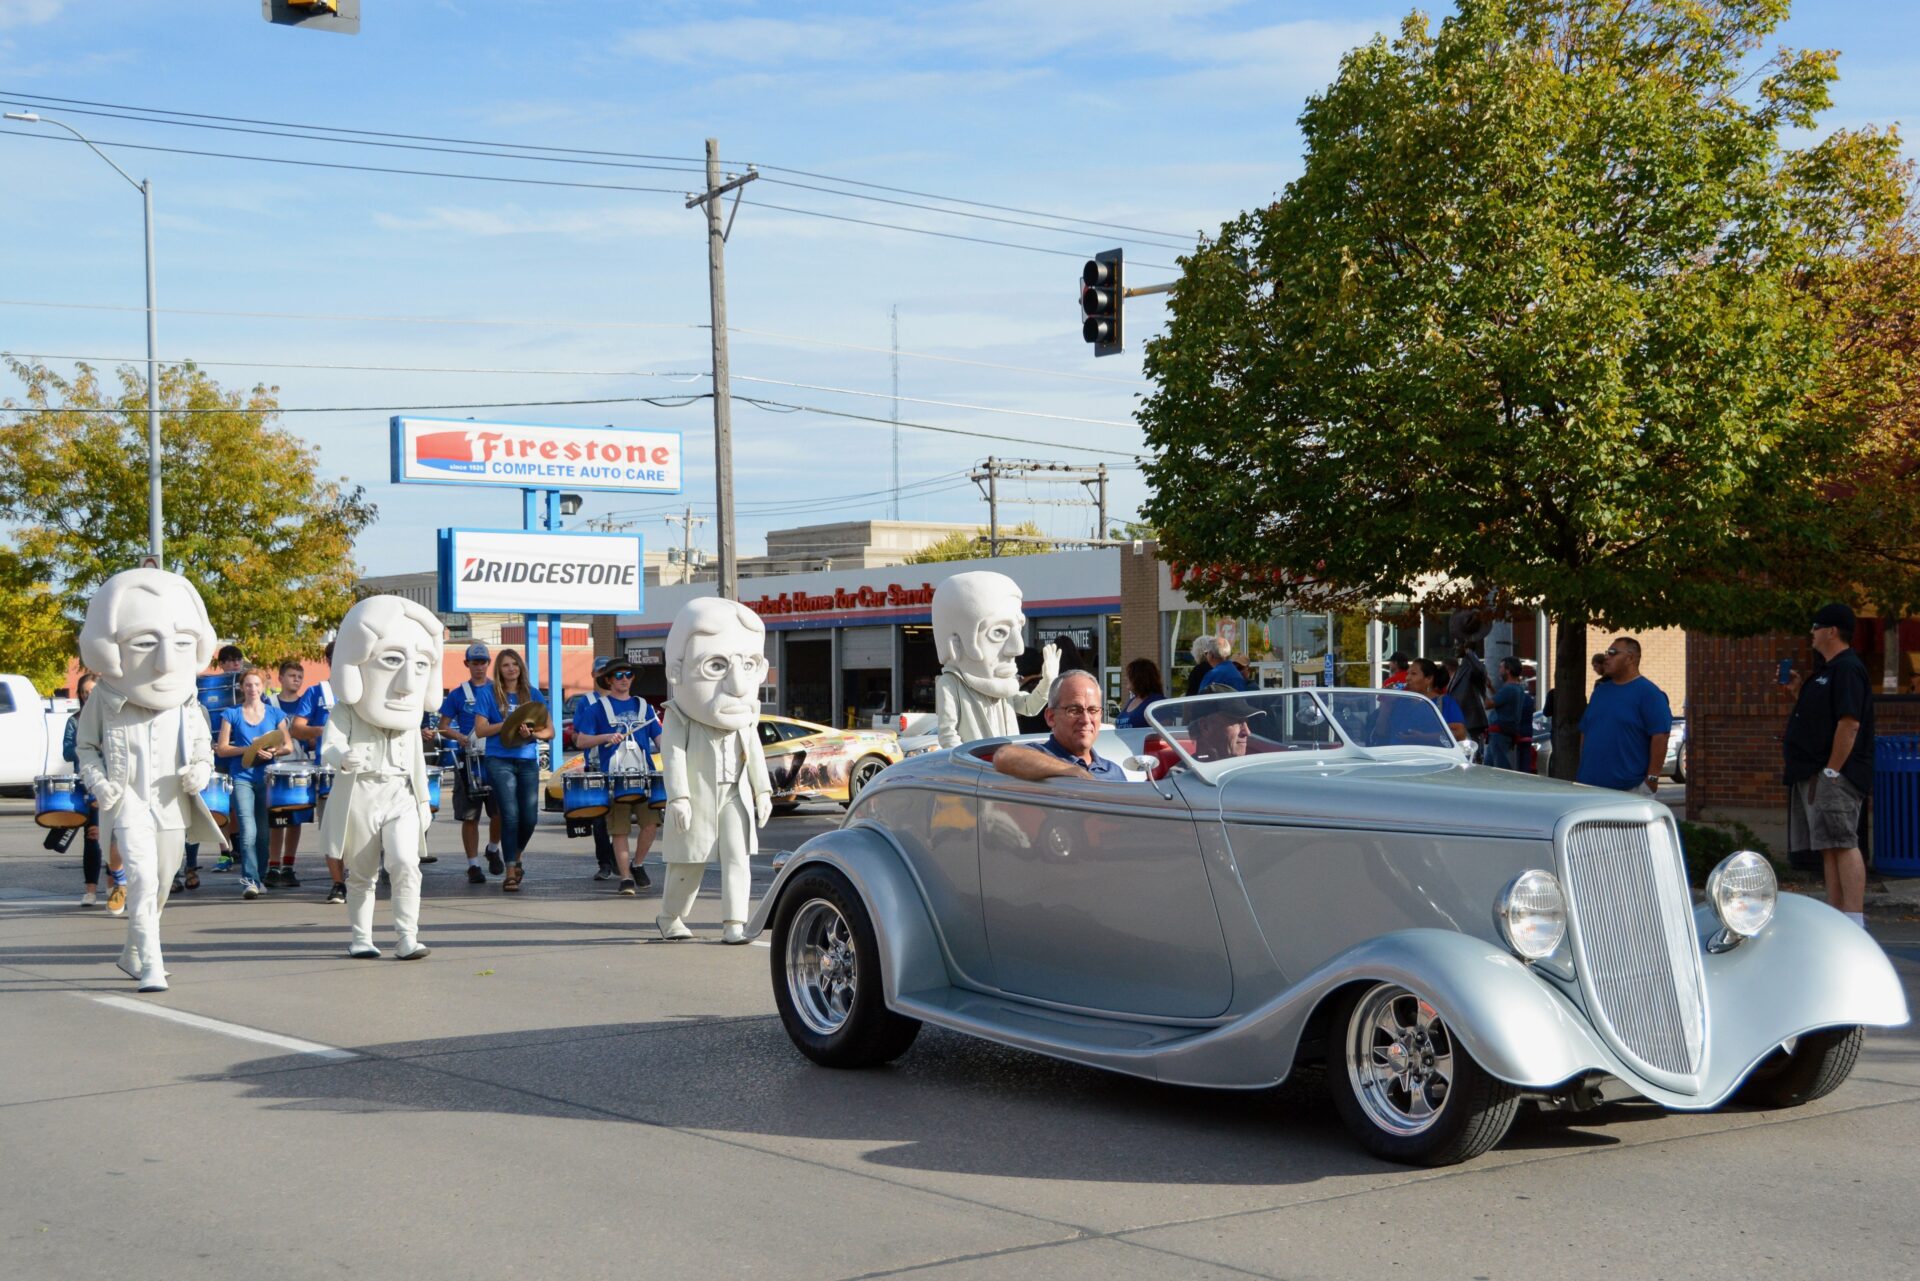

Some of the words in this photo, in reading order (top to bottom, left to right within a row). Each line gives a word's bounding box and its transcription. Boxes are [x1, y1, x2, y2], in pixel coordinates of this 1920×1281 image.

[477, 432, 670, 465] Firestone
[492, 462, 574, 477] COMPLETE
[580, 466, 621, 480] AUTO
[626, 468, 665, 481] CARE
[462, 558, 636, 585] BRIDGESTONE
[792, 590, 834, 611] Home
[834, 587, 858, 608] for
[858, 585, 887, 608] Car
[1291, 650, 1310, 663] 425
